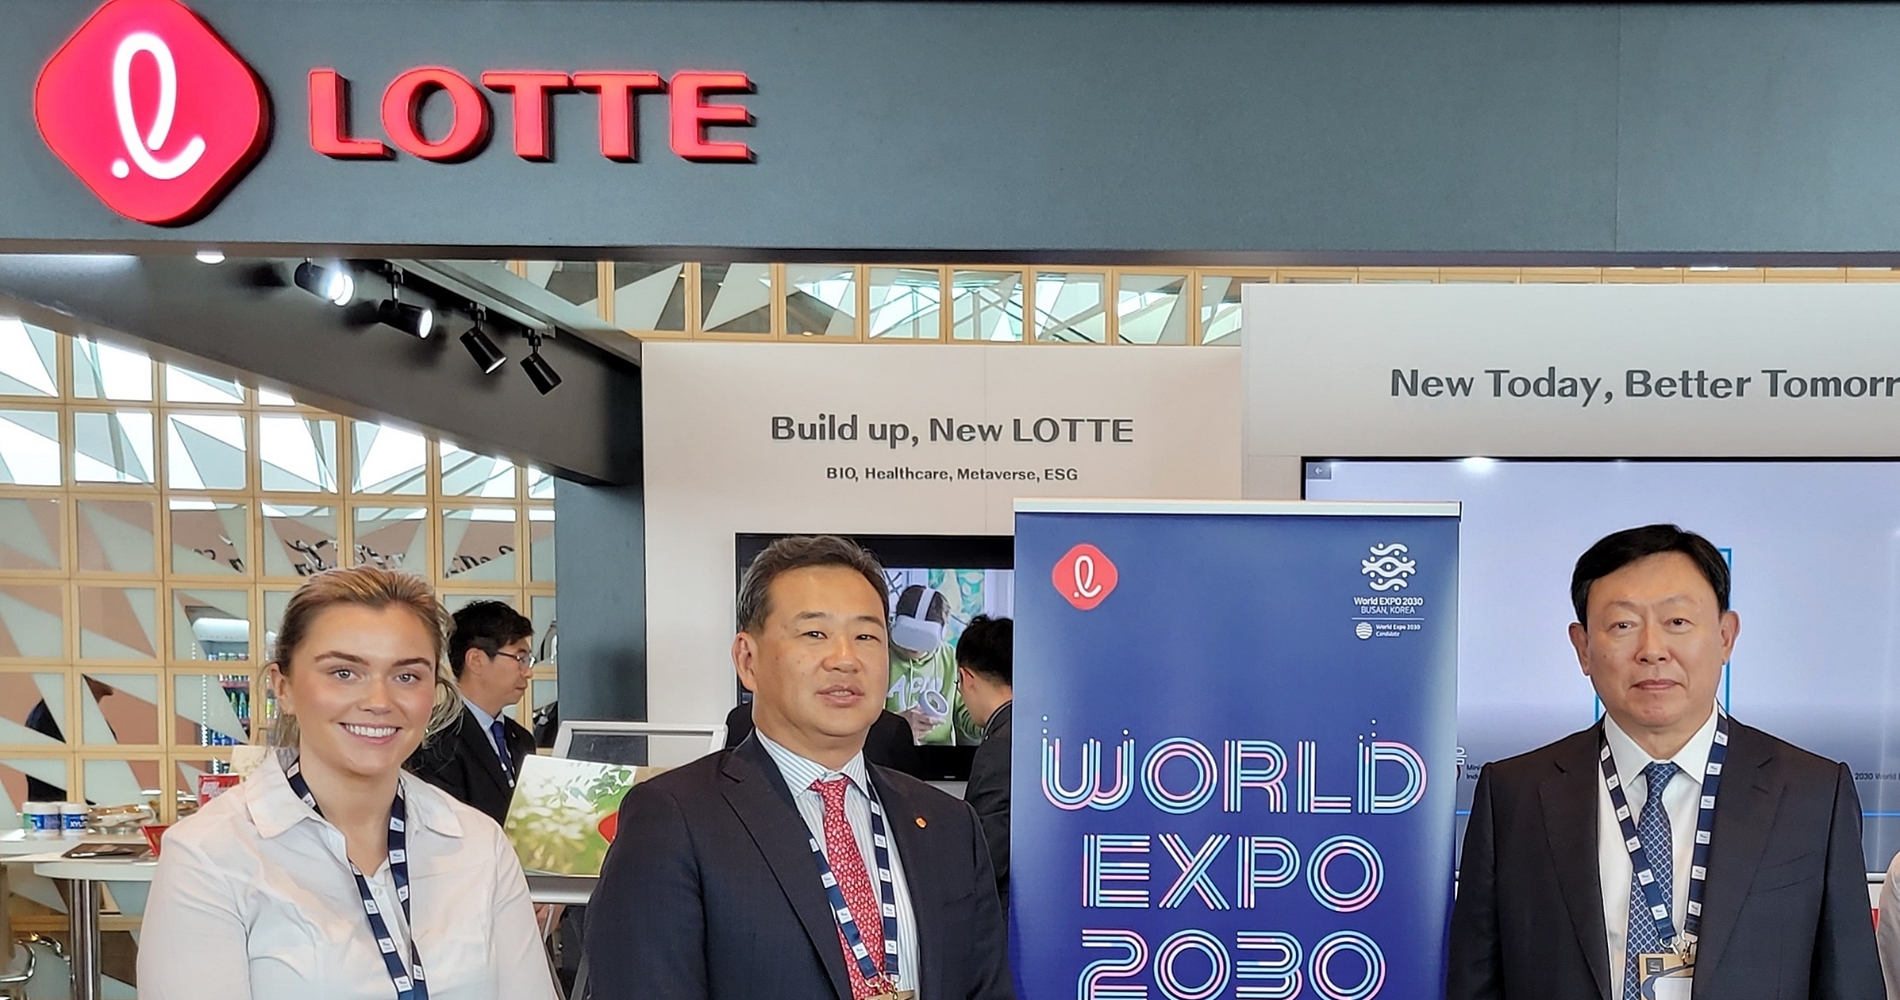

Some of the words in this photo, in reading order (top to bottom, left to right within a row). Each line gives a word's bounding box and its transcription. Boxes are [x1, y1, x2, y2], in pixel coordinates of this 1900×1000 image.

[308, 67, 753, 162] LOTTE
[1391, 368, 1474, 397] New
[1484, 366, 1614, 407] Today,
[1625, 369, 1752, 398] Better
[771, 413, 858, 441] Build
[868, 422, 920, 449] up,
[929, 417, 1003, 442] New
[1013, 417, 1134, 443] LOTTE
[826, 467, 859, 483] BIO,
[864, 466, 953, 482] Healthcare,
[956, 467, 1040, 483] Metaverse,
[1044, 468, 1078, 481] ESG
[1353, 596, 1378, 606] World
[1379, 597, 1402, 606] EXPO
[1402, 597, 1424, 606] 2030
[1361, 606, 1388, 614] BUSAN,
[1390, 606, 1416, 614] KOREA
[1042, 735, 1428, 815] WORLD
[1082, 834, 1385, 913] EXPO
